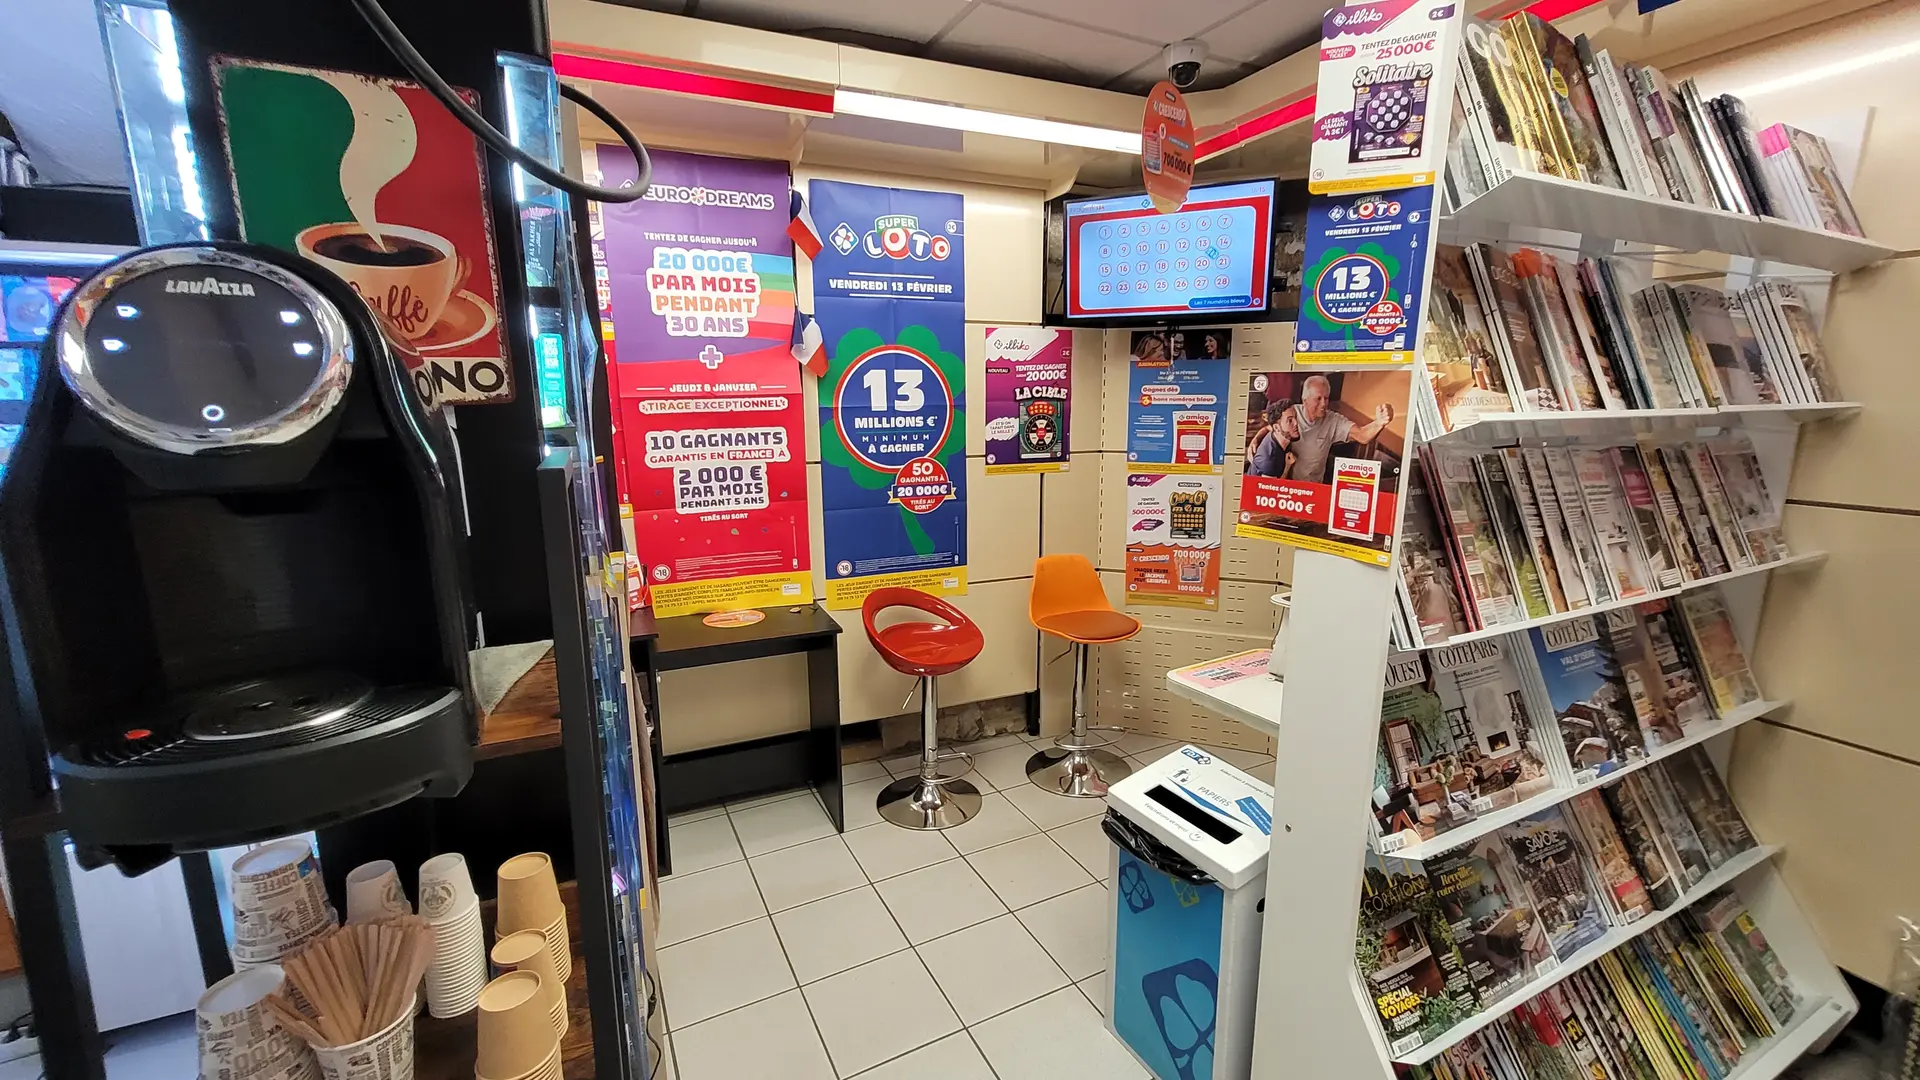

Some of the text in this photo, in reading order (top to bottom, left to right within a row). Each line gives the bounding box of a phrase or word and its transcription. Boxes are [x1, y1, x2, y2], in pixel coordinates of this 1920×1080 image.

[1361, 31, 1437, 50] TENTEZ DE GAGNER
[1353, 61, 1433, 86] Solitaire
[1159, 103, 1186, 121] CRESCENDO
[1348, 201, 1400, 219] LOTO
[877, 217, 916, 229] SUPER
[1141, 225, 1146, 233] 3
[1181, 221, 1186, 229] 5
[1201, 219, 1206, 227] 6
[1222, 217, 1227, 225] 7
[1325, 223, 1402, 236] VENDREDI 13 FÉVRIER
[644, 232, 675, 242] TENTEZ
[678, 234, 689, 243] DE
[690, 235, 722, 245] GAGNER
[864, 228, 950, 260] LOTO
[1103, 237, 1229, 255] 8 9 10 11 12 13 14
[658, 253, 748, 273] 20 000€
[1101, 257, 1227, 274] 15 16 17 18 19 20 21
[652, 274, 757, 293] PAR MOIS
[829, 278, 952, 294] VENDREDI 13 FÉVRIER
[1100, 284, 1110, 292] 22
[1118, 283, 1128, 291] 23
[1137, 282, 1147, 290] 24
[1156, 281, 1166, 289] 25
[1217, 277, 1227, 285] 28
[1333, 266, 1371, 291] 13
[165, 277, 256, 297] LAVAZZA
[1325, 291, 1367, 300] MILLIONS
[656, 295, 755, 314] PENDANT
[671, 316, 744, 333] 30 ANS
[1003, 339, 1030, 350] illiko
[669, 383, 757, 392] JEUDI 8 JANVIER
[863, 369, 925, 412] 13
[1015, 385, 1067, 400] LA CIBLE
[647, 400, 781, 411] TIRAGE EXCEPTIONNEL
[854, 416, 923, 429] MILLIONS
[1186, 414, 1209, 424] amigo
[650, 432, 783, 450] 10 GAGNANTS
[862, 434, 930, 442] MINIMUM
[650, 448, 786, 464] GARANTIS EN FRANCE À
[868, 443, 924, 453] À GAGNER
[678, 465, 763, 485] 2 000 €
[912, 462, 933, 475] 50
[1348, 464, 1373, 477] amigo
[680, 483, 764, 499] PAR MOIS
[897, 485, 947, 496] 20 000€
[1258, 483, 1279, 492] Tentez
[1289, 488, 1314, 497] gagner
[681, 496, 765, 509] PENDANT 5 ANS
[1256, 496, 1315, 514] 100 000 €
[700, 514, 720, 522] TIRÉS
[721, 513, 731, 521] AU
[1197, 786, 1232, 807] PAPIERS
[1526, 830, 1560, 853] SAVOIE
[1380, 993, 1421, 1019] VOYAGES
